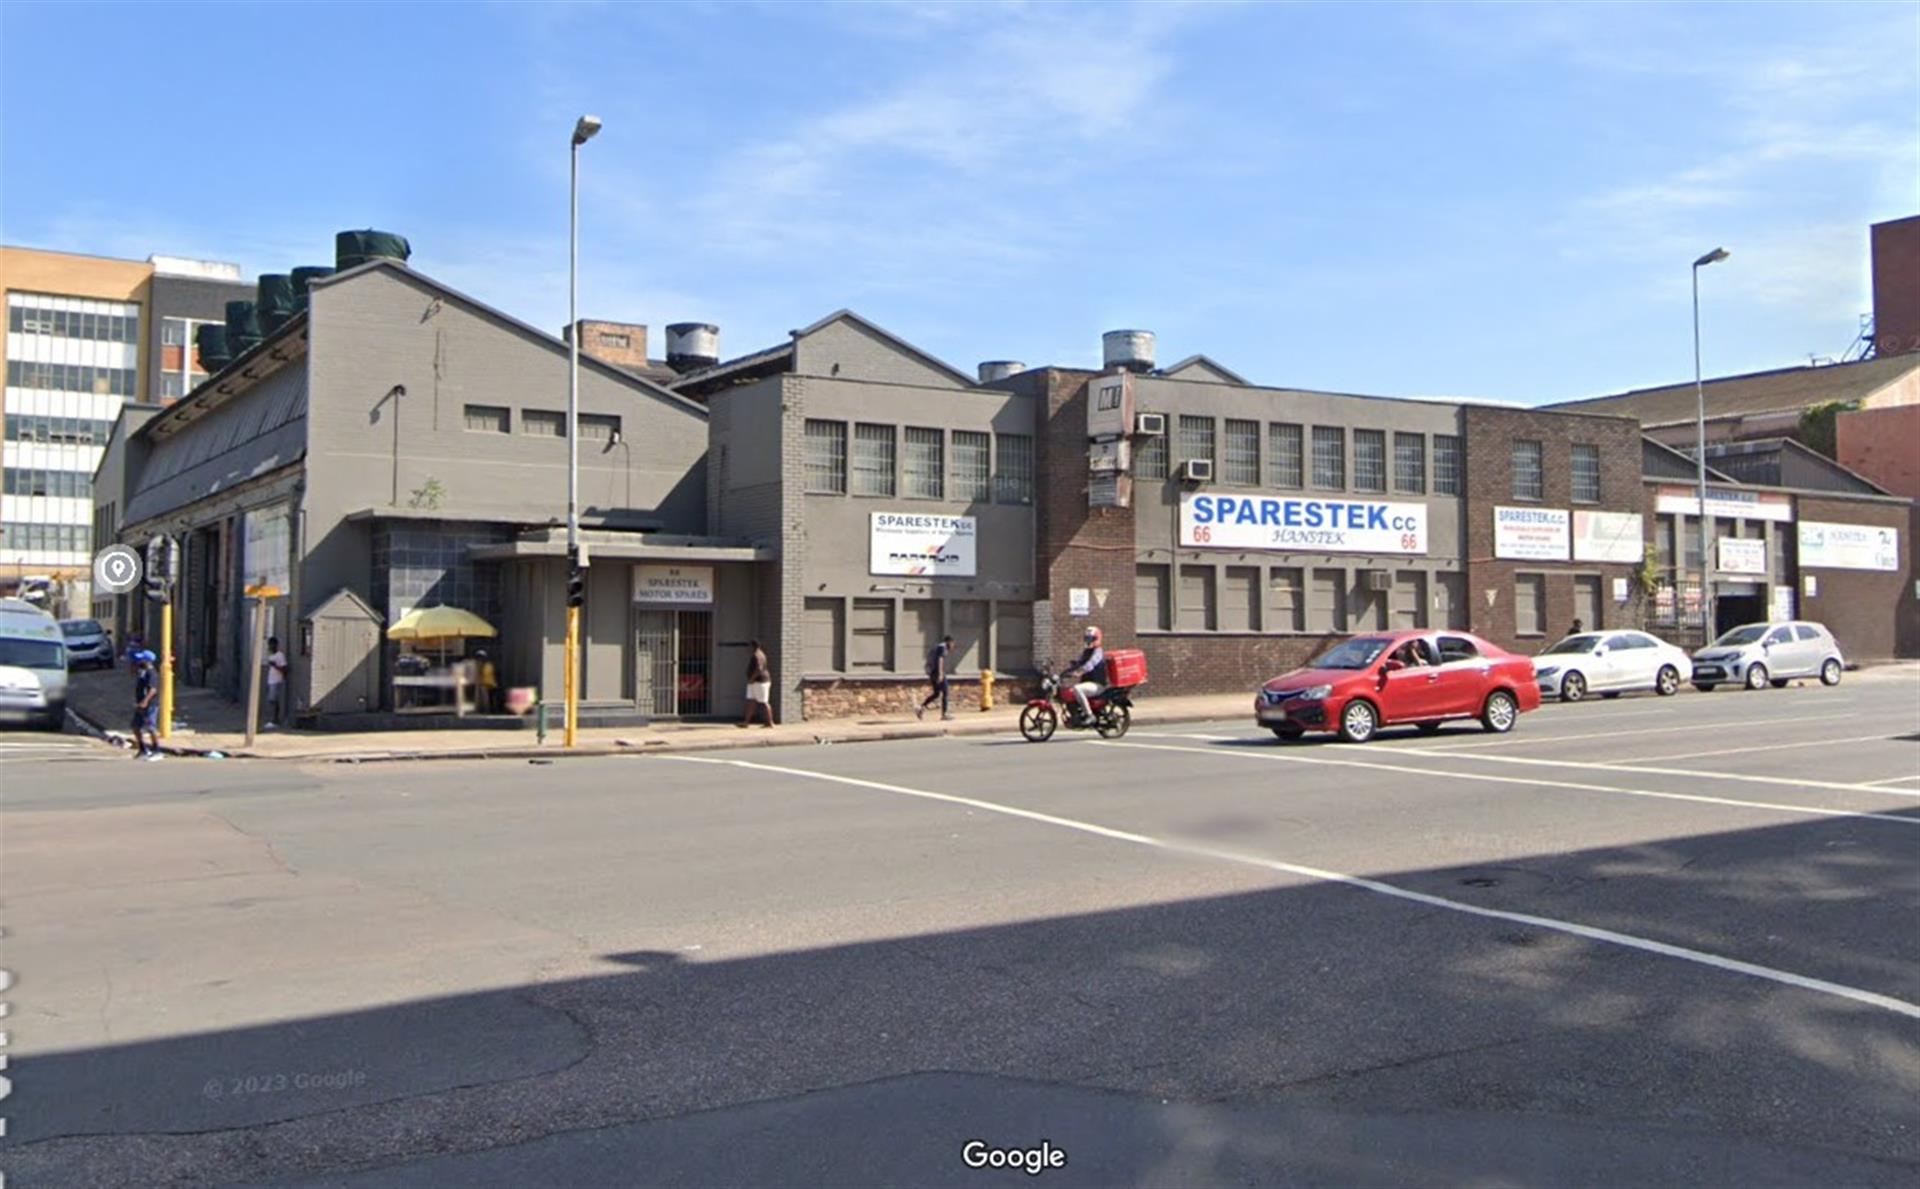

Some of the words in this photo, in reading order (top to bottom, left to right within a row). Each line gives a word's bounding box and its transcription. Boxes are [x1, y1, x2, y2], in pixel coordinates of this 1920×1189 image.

[878, 515, 960, 529] SPARESTEK
[1193, 497, 1389, 531] SPARESTEK
[1193, 526, 1211, 543] 66
[1272, 529, 1346, 545] HANSTEK
[1401, 534, 1417, 550] 66
